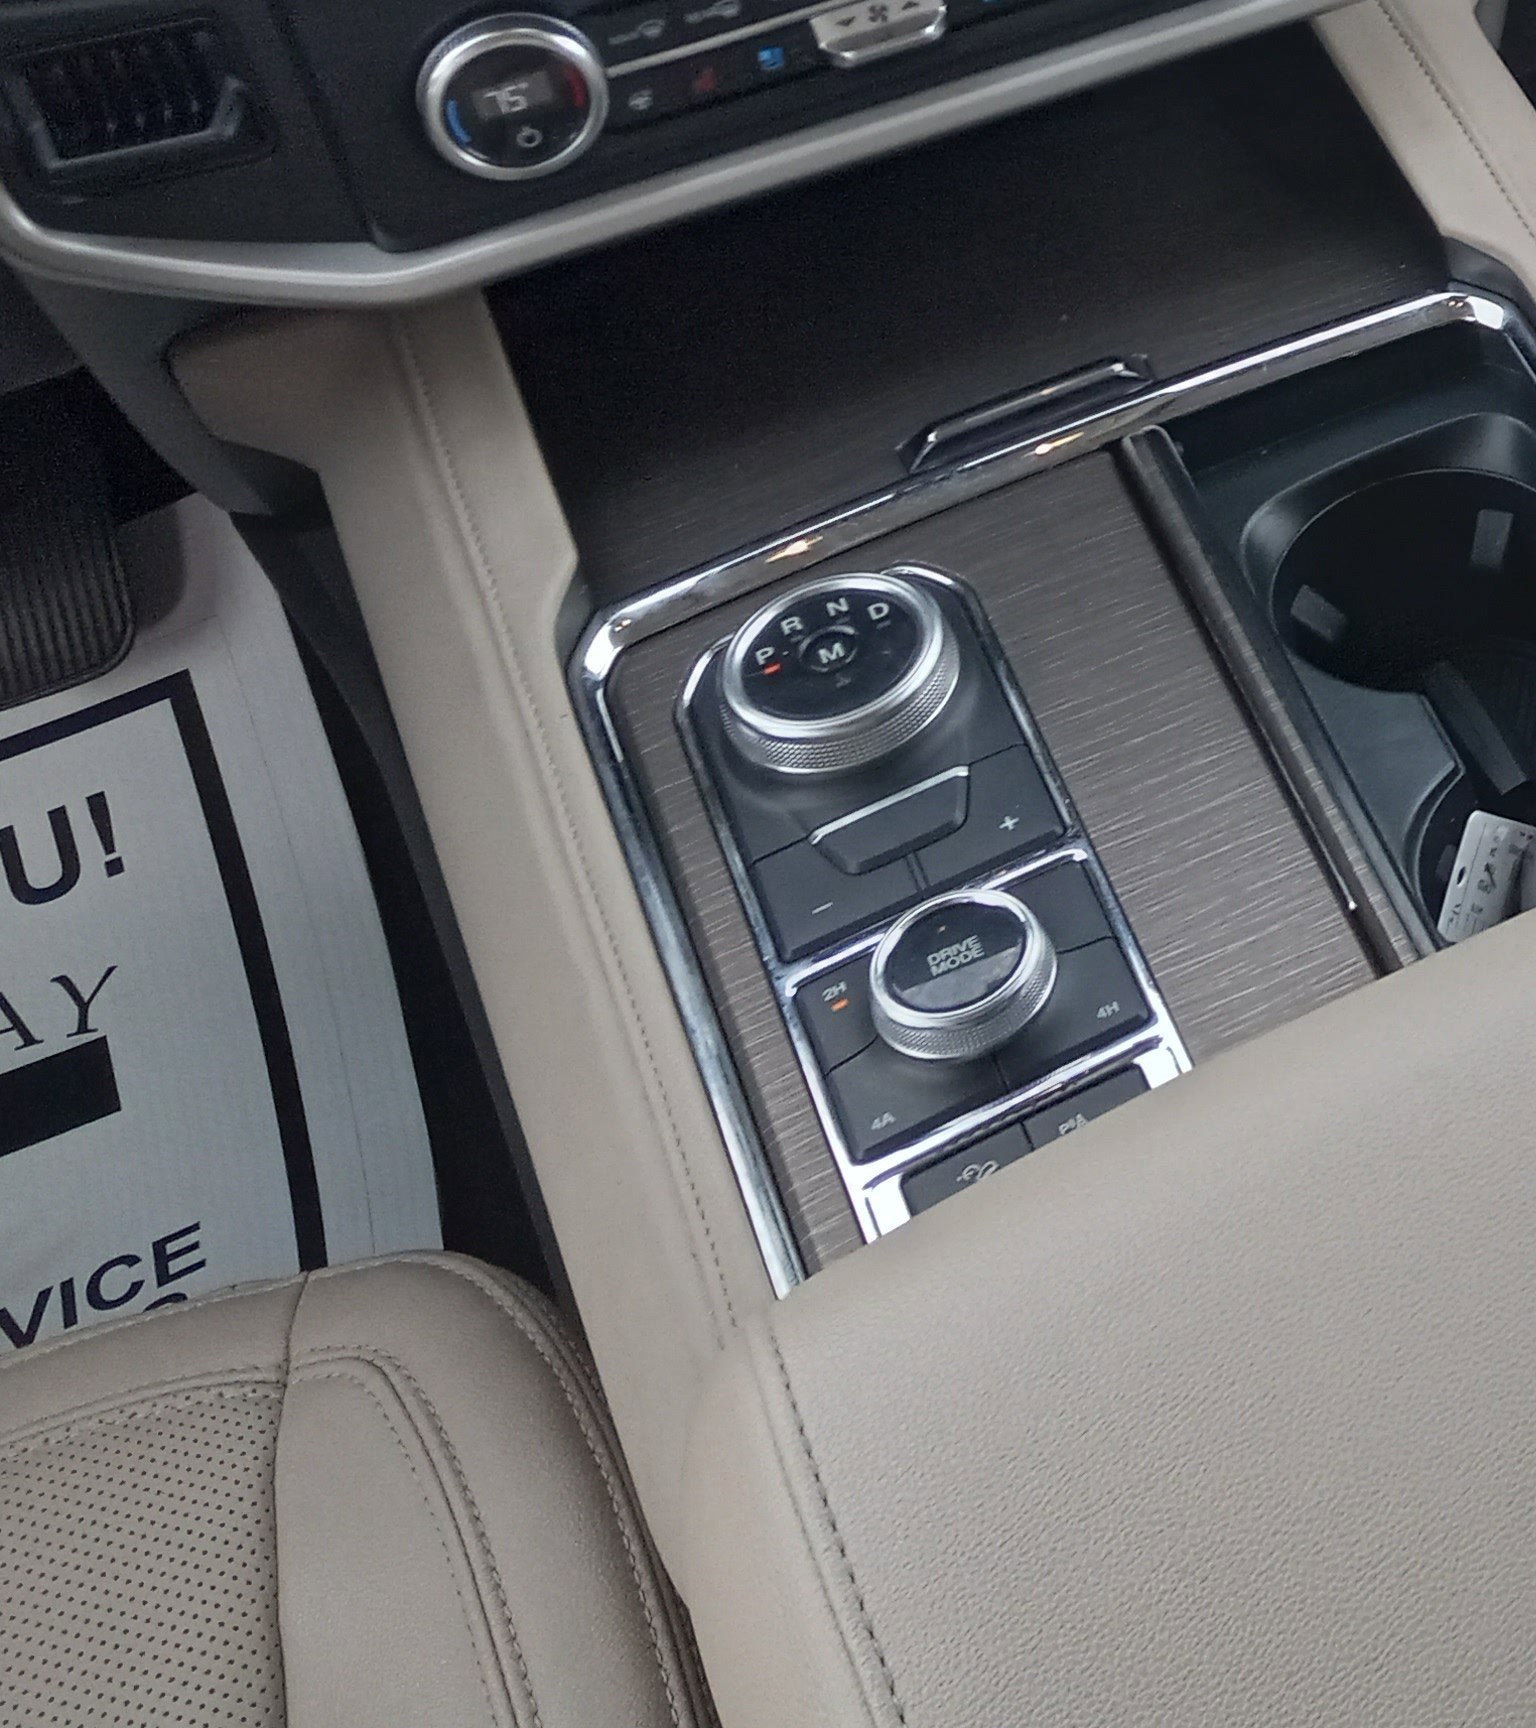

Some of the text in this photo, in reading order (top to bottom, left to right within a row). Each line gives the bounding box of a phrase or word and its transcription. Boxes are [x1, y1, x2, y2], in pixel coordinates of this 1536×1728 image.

[826, 597, 849, 617] N
[867, 602, 890, 620] D
[781, 616, 804, 635] R
[755, 646, 775, 665] P
[818, 642, 845, 664] M
[927, 934, 979, 966] DRIVE
[930, 942, 985, 977] MODE
[822, 981, 848, 1002] 2H
[1096, 1001, 1120, 1020] 4H
[871, 1111, 896, 1130] 4A
